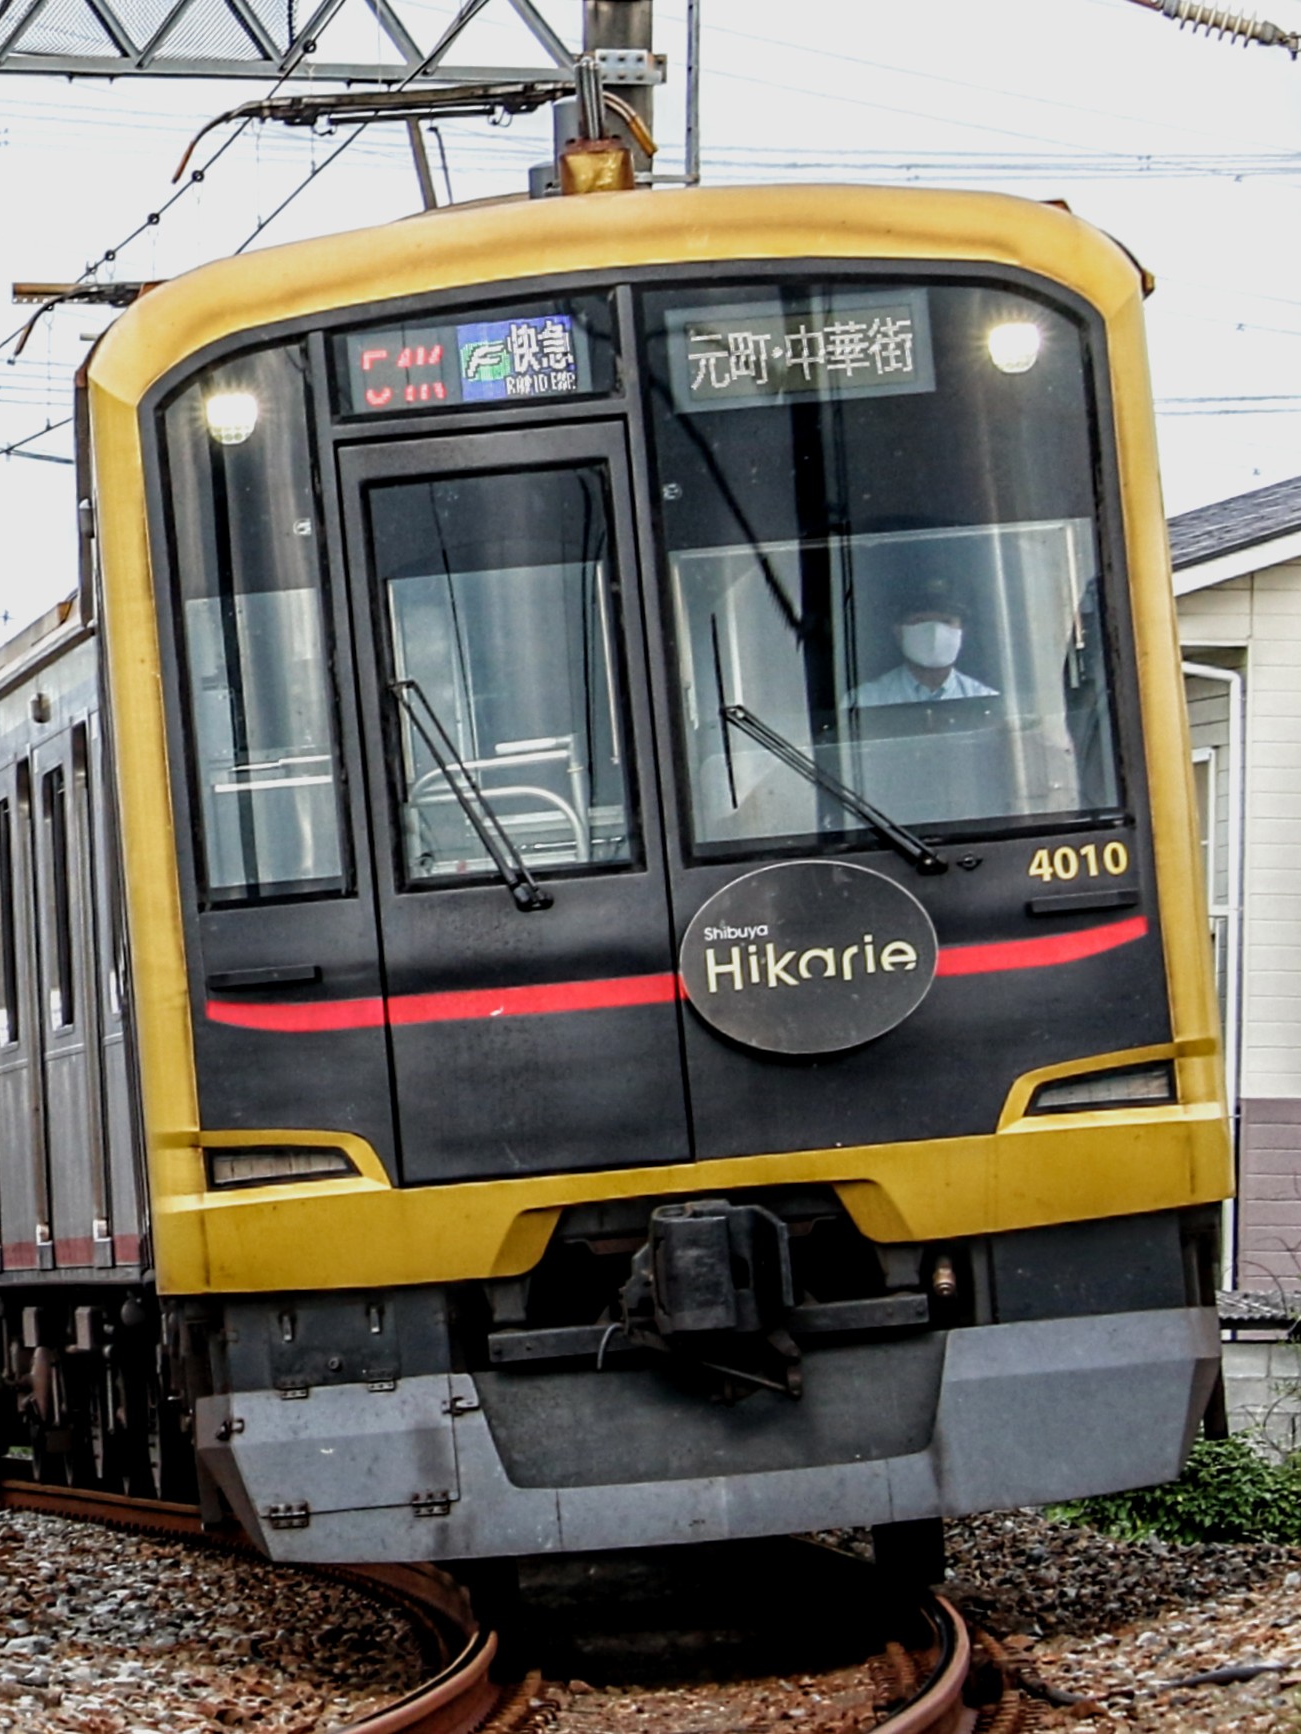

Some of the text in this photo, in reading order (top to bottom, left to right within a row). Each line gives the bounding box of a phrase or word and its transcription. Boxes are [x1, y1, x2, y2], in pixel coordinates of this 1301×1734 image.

[506, 320, 575, 374] 快急
[1027, 841, 1129, 883] 4010
[703, 924, 769, 942] Shibuya
[706, 934, 918, 994] Hikarie
